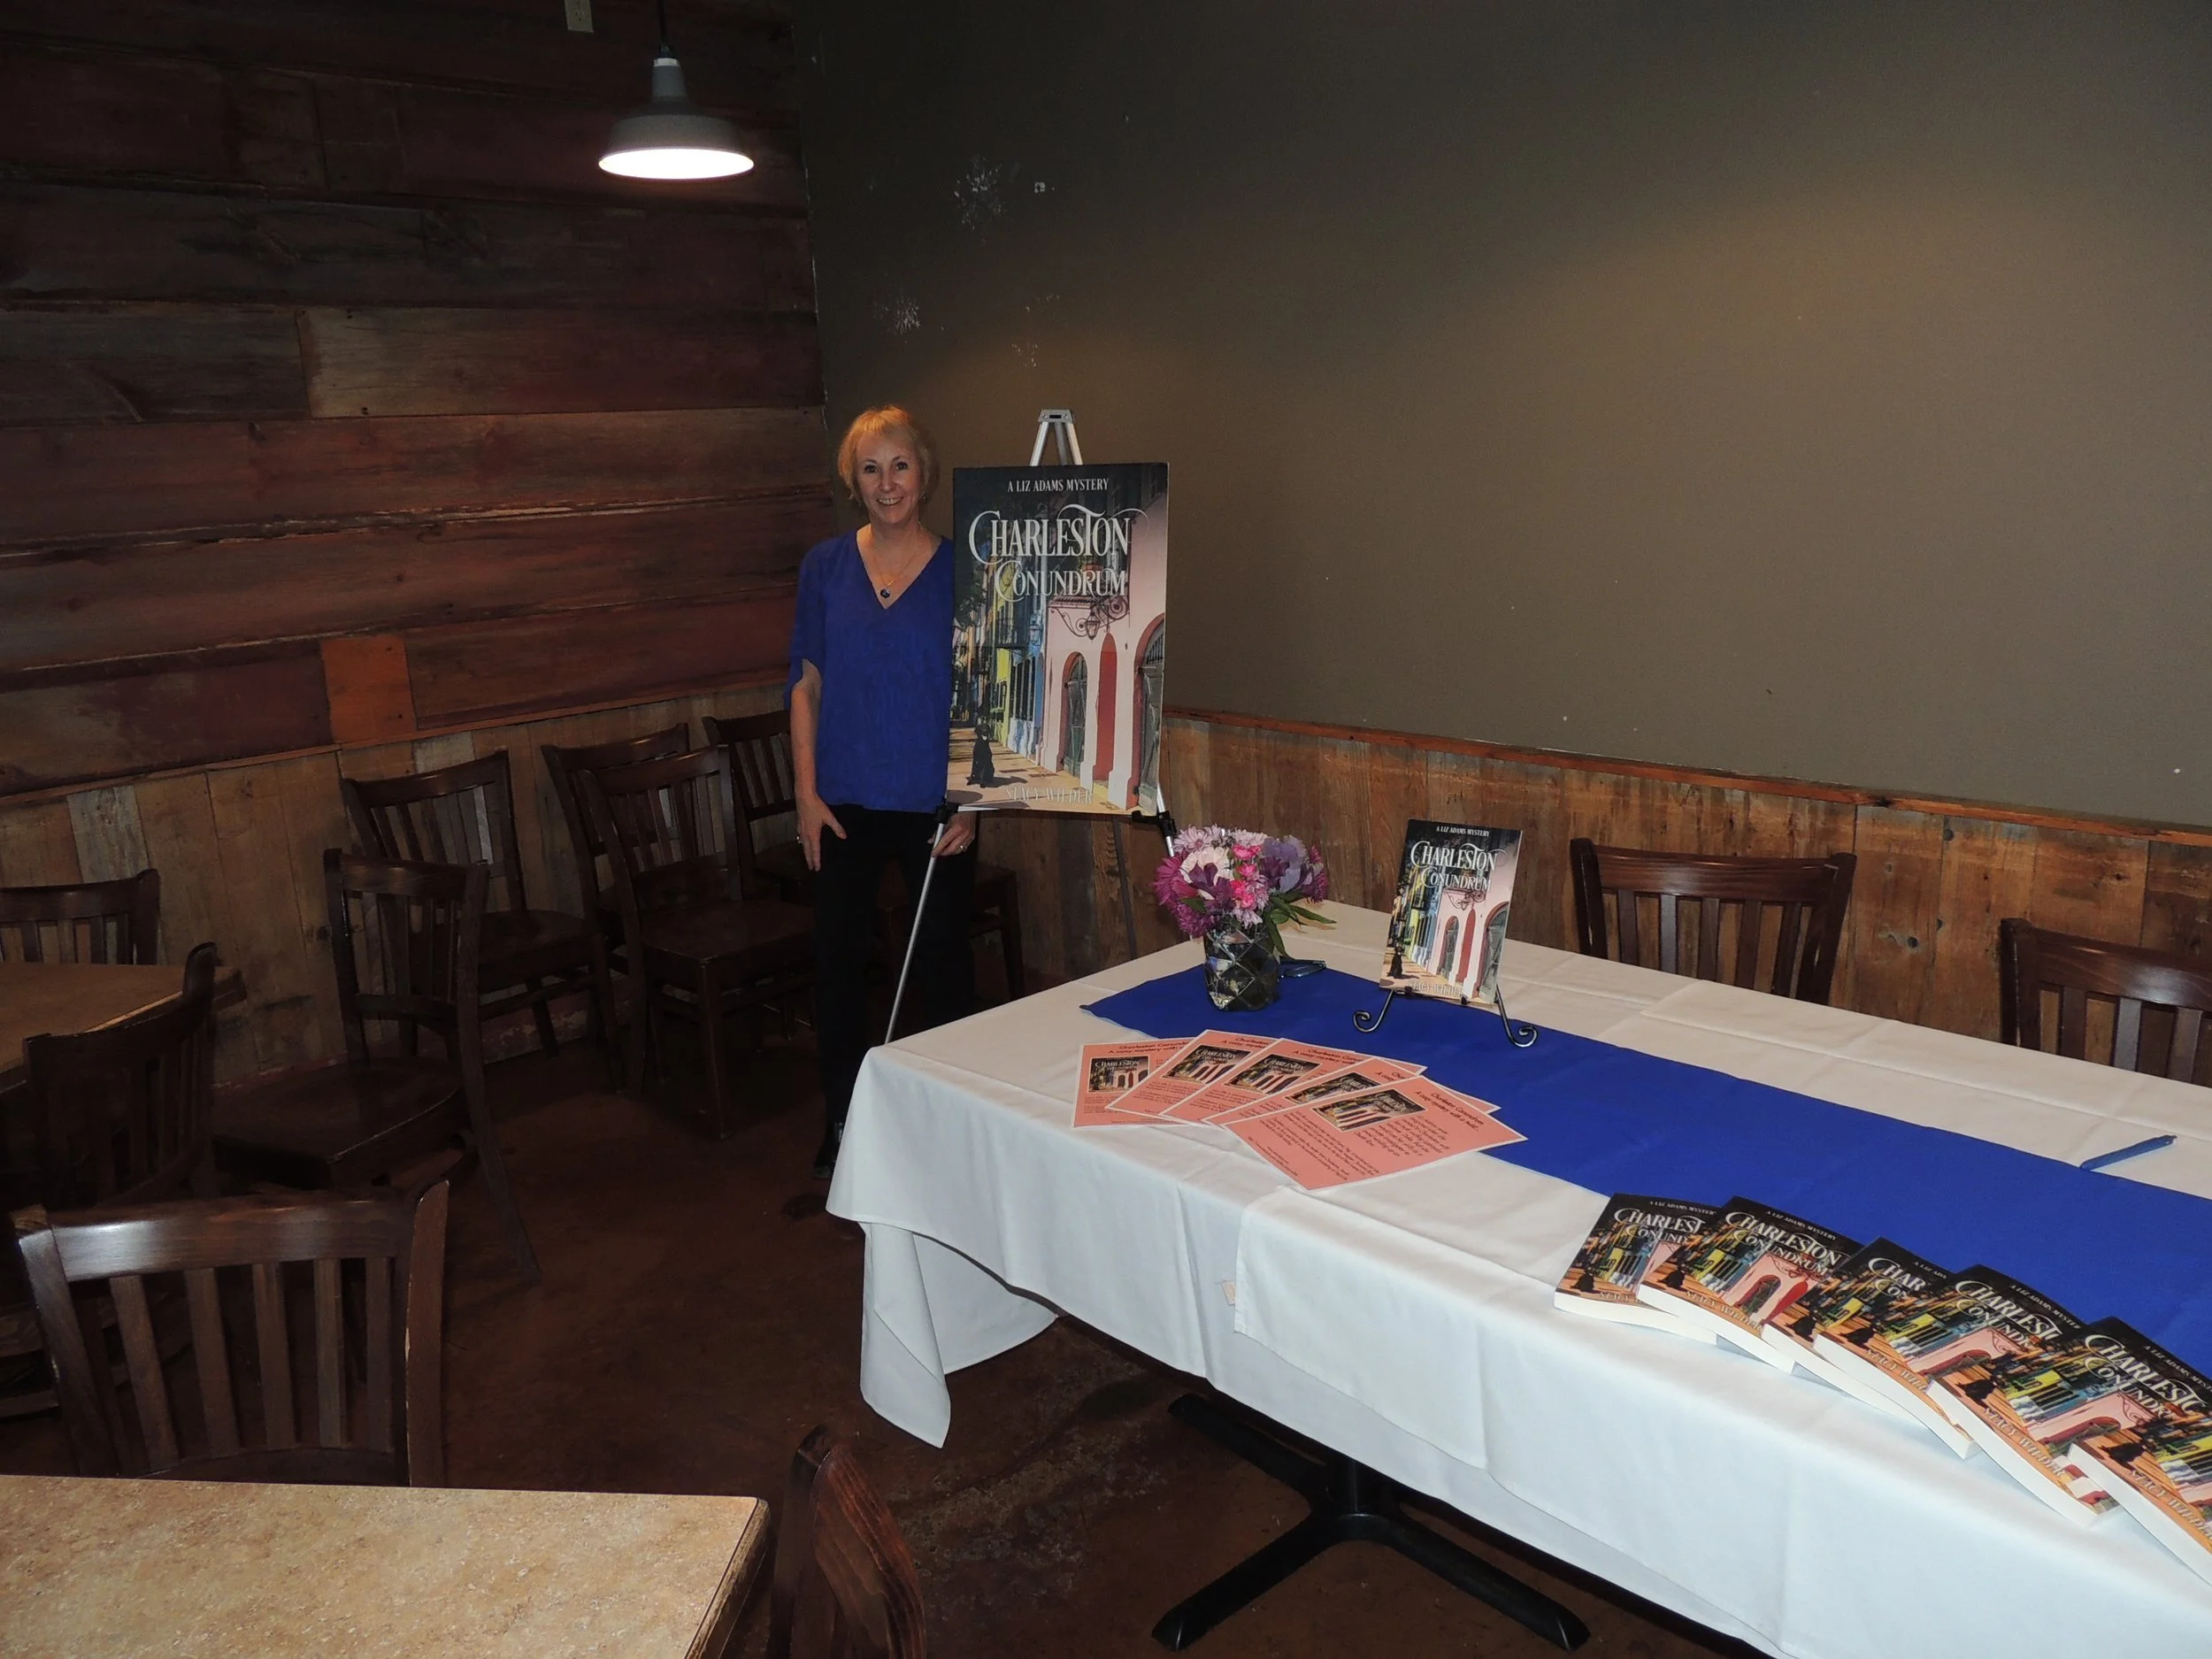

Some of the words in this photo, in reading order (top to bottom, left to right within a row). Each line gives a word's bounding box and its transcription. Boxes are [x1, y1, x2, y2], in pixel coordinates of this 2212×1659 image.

[1008, 480, 1014, 492] A
[1017, 480, 1031, 492] LIZ
[1033, 479, 1064, 492] ADAMS
[1066, 478, 1109, 492] MYSTERY
[968, 503, 1149, 565] CHARLESTON
[995, 560, 1127, 603] CONUNDRUM
[1410, 840, 1508, 872] CHARLESTON
[1421, 867, 1492, 892] CONUNDRUM
[1614, 1208, 1706, 1234] CHARLEST
[1688, 1206, 1717, 1216] MYSTER
[1725, 1211, 1852, 1266] CHARLESTON
[1955, 1280, 2062, 1340] CHARLEST
[2053, 1309, 2082, 1329] MYSTER
